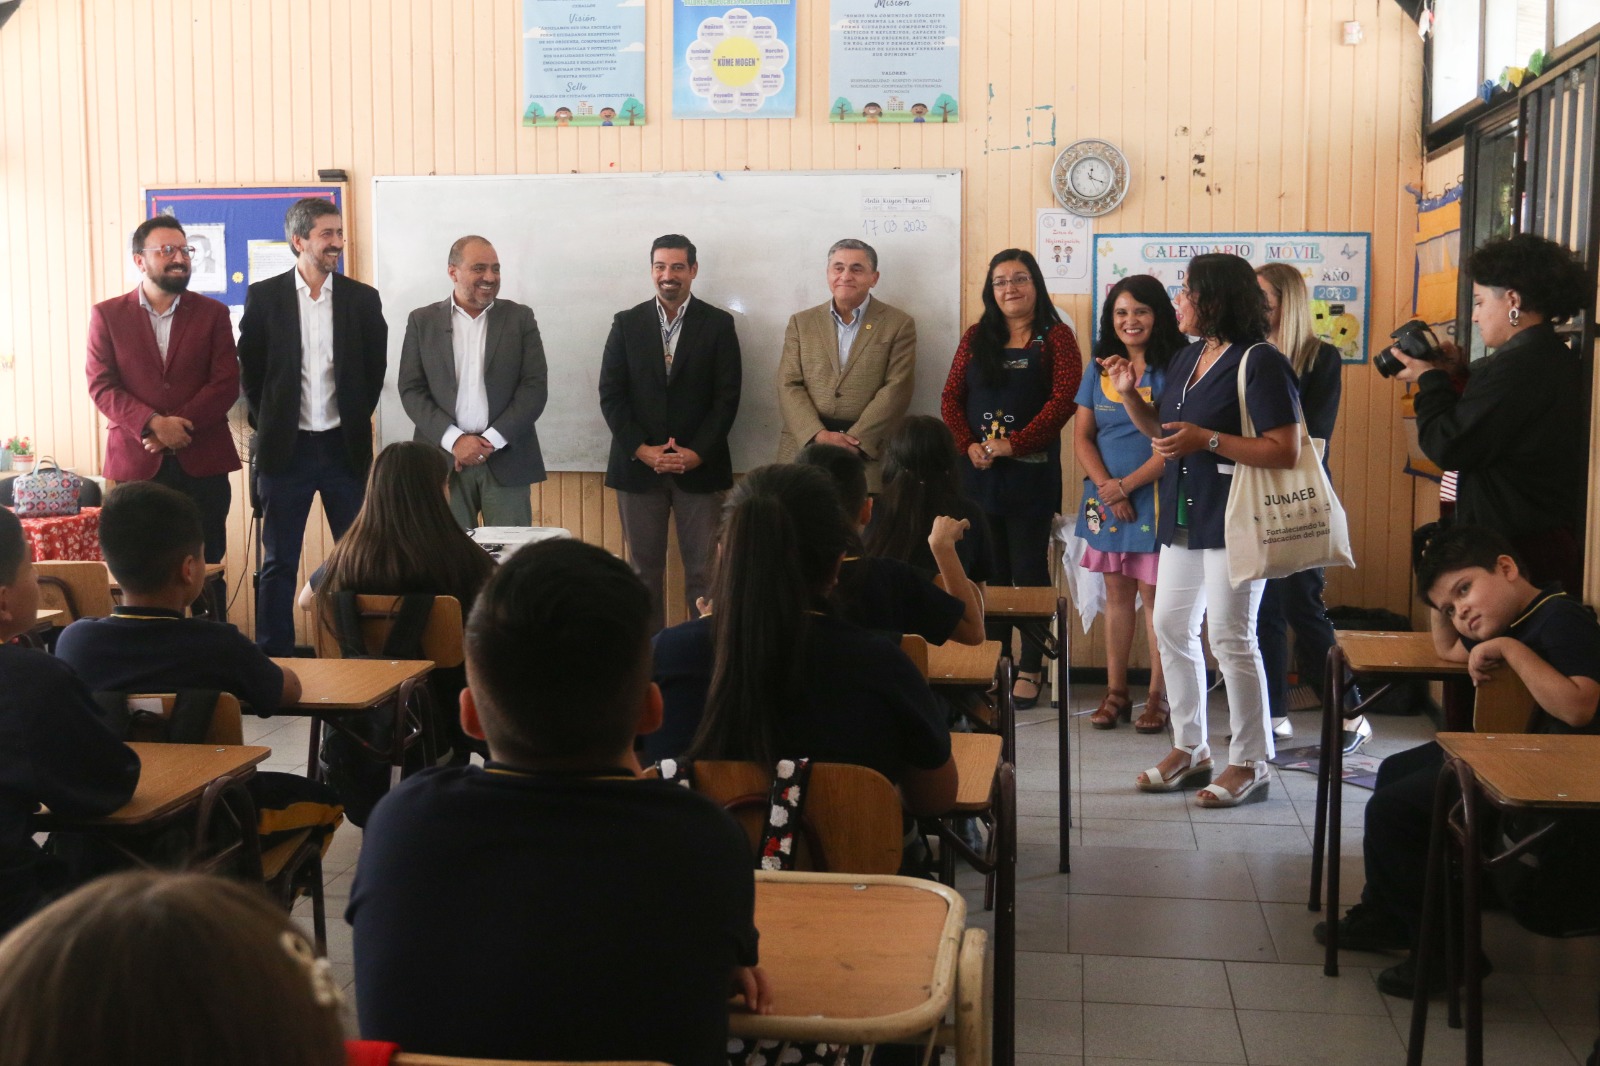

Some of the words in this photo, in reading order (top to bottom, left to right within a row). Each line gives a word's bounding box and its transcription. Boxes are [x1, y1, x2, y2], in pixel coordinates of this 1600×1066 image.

[569, 14, 596, 23] Visión
[566, 82, 587, 92] Sello
[862, 219, 879, 236] 17
[884, 220, 897, 233] 03
[904, 219, 927, 232] 2023
[1145, 244, 1250, 258] CALENDARIO
[1319, 287, 1351, 299] 2023
[1264, 488, 1316, 506] JUNAEB
[1266, 522, 1317, 535] Fortaleciendo
